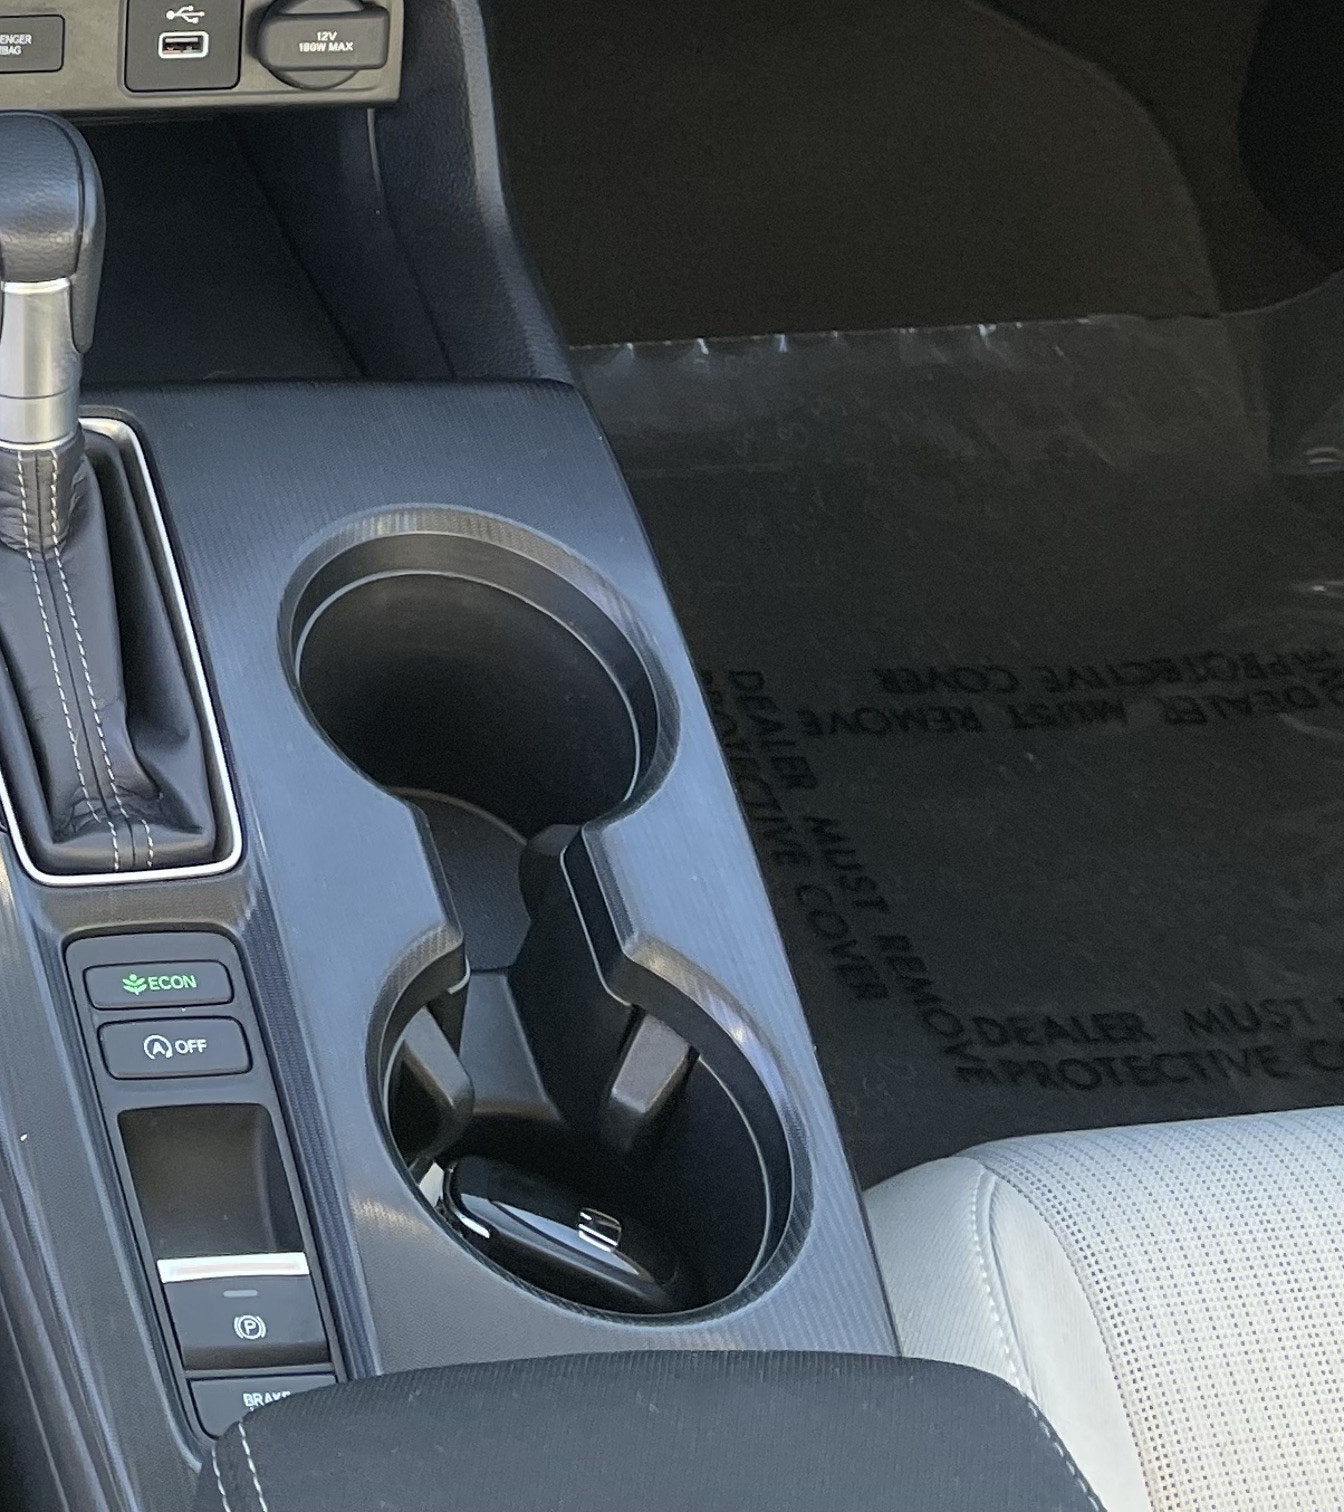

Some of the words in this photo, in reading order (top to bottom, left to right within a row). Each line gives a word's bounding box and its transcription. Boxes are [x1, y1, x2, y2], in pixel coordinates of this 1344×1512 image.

[316, 31, 338, 42] 12V
[328, 41, 354, 52] MAX
[148, 973, 198, 992] ECON
[972, 1009, 1158, 1049] DEALER
[1181, 997, 1316, 1039] MUST
[174, 1038, 208, 1056] OFF
